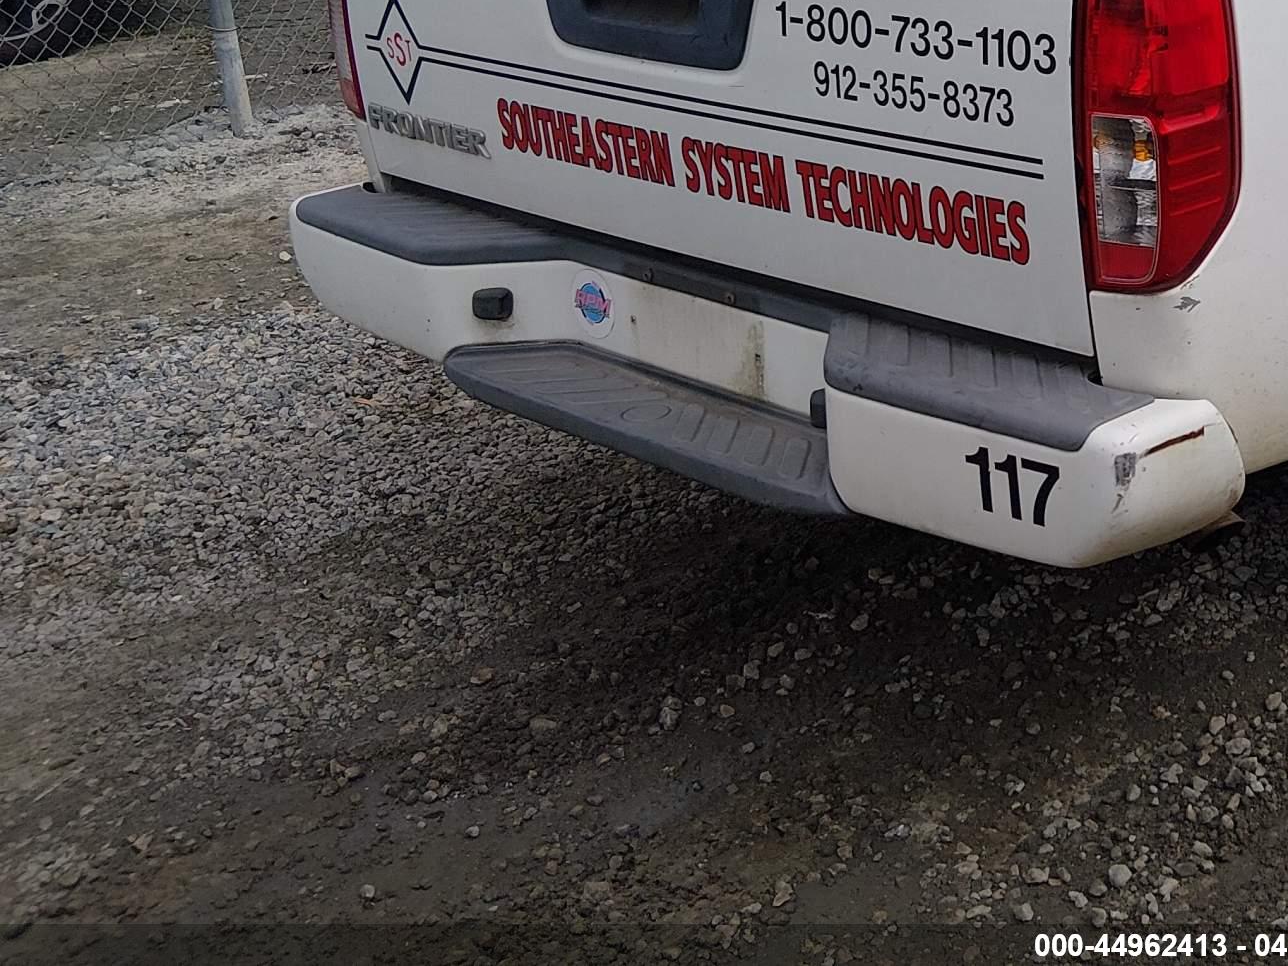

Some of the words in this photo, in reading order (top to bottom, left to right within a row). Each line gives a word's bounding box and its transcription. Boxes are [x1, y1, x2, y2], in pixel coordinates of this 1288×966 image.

[386, 32, 413, 67] SST
[775, 0, 1058, 75] 1-800-733-1103
[813, 60, 1015, 127] 912-355-8373
[367, 102, 492, 161] FRONTIER
[496, 97, 677, 187] SOUTHEASTERN
[681, 136, 791, 214] SYSTEM
[795, 159, 1032, 266] TECHNOLOGIES
[964, 444, 1062, 528] 117
